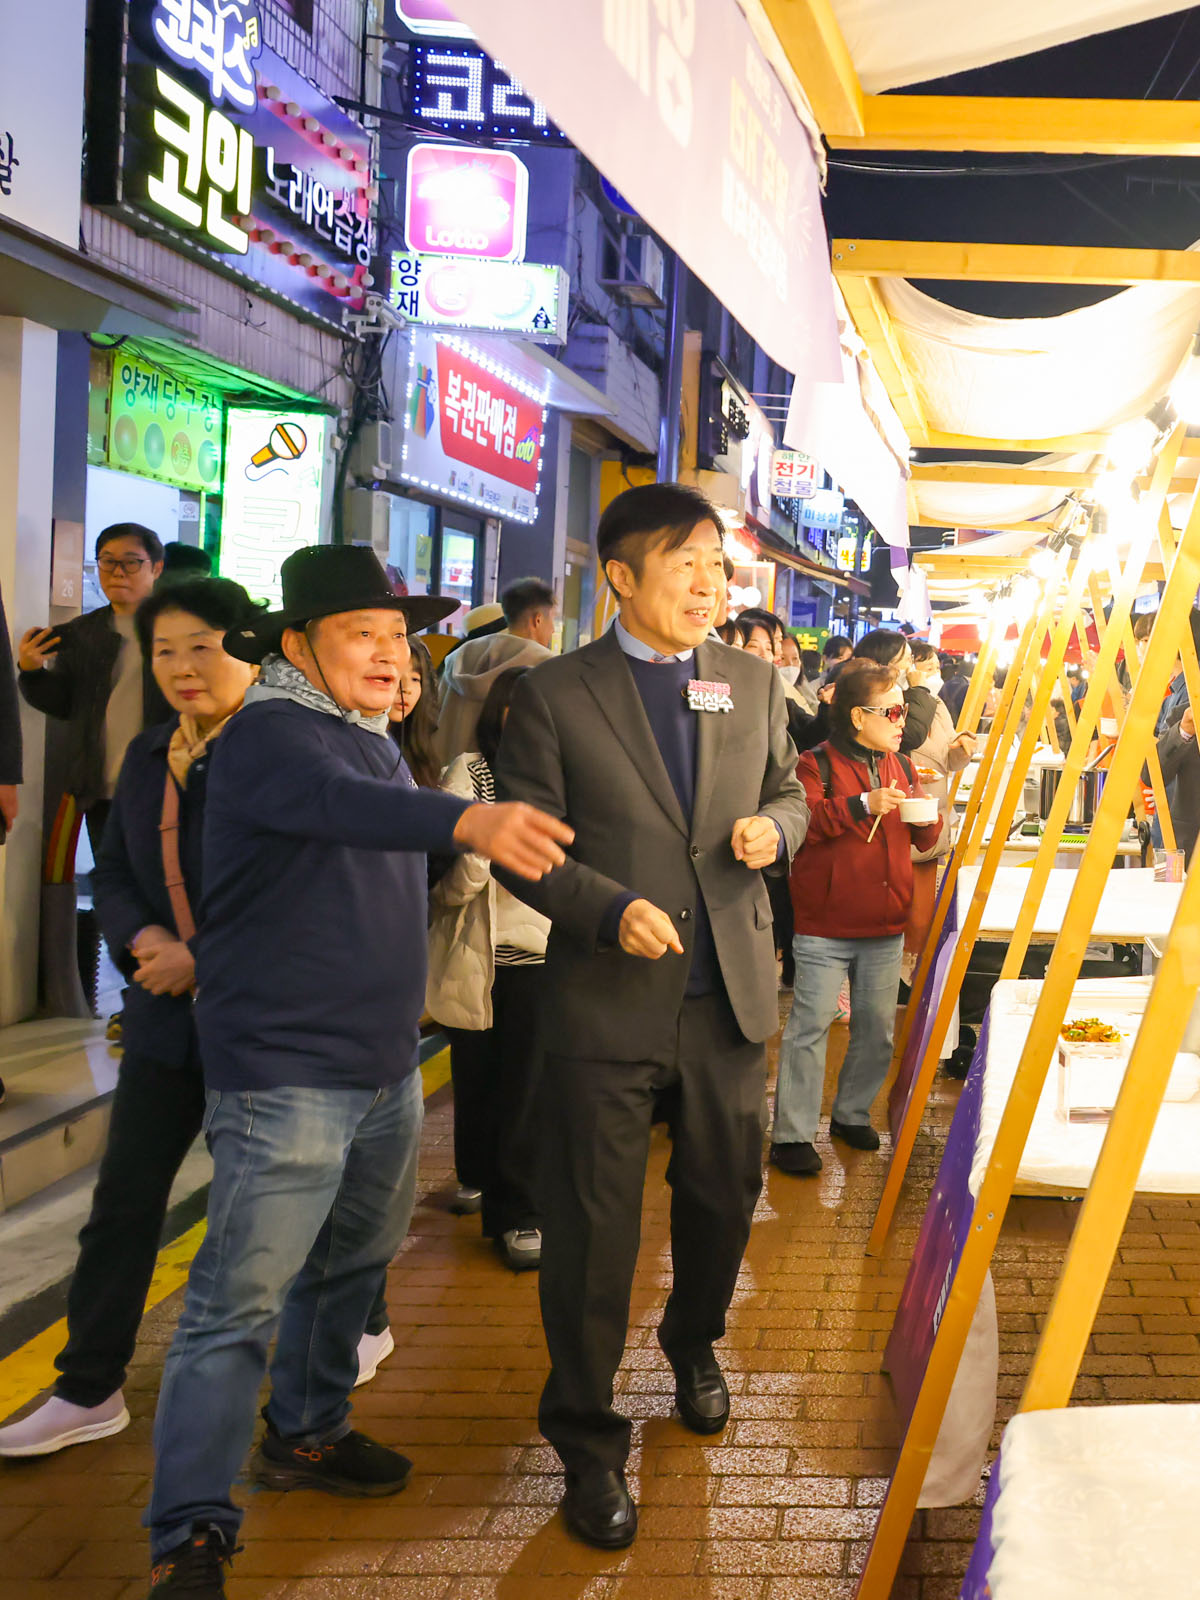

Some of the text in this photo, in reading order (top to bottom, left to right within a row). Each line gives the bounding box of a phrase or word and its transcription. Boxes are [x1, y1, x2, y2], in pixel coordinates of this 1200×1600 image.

[148, 68, 253, 254] 코인
[265, 146, 371, 266] 노래연습장
[425, 225, 489, 249] Lotto
[397, 259, 421, 317] 양재
[444, 369, 517, 460] 복권판매점
[774, 479, 813, 496] 철물
[775, 462, 814, 479] 전기
